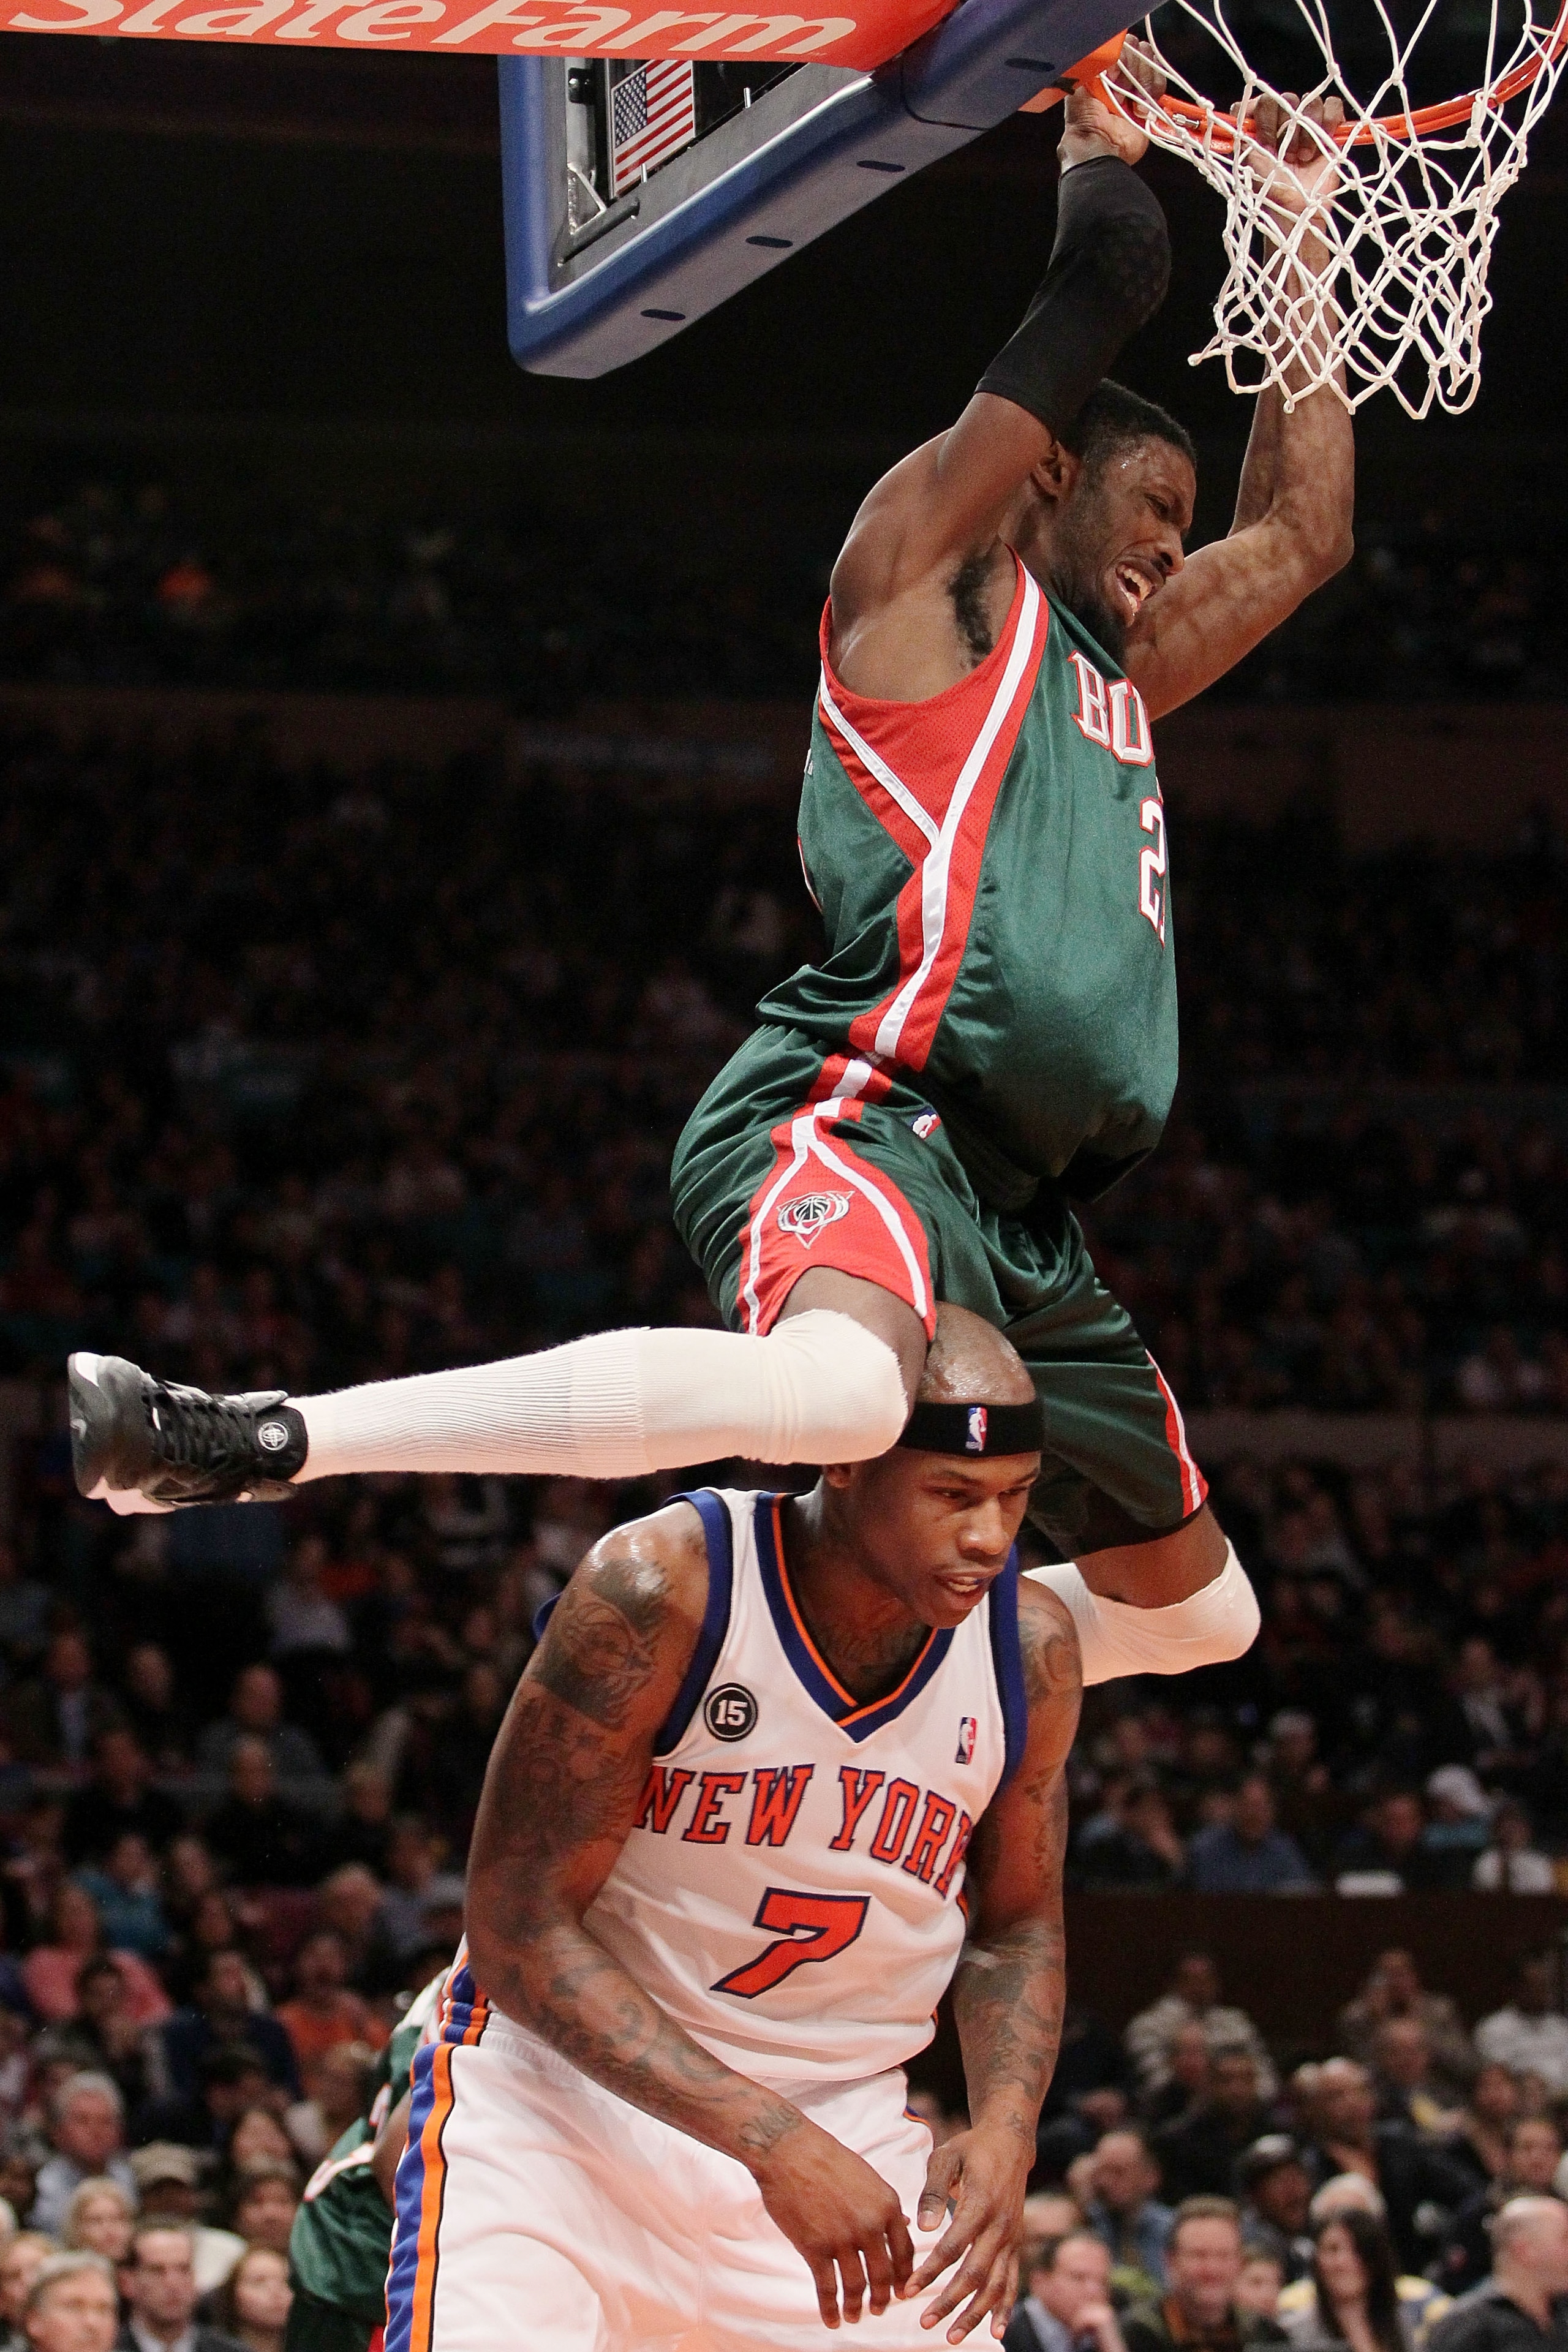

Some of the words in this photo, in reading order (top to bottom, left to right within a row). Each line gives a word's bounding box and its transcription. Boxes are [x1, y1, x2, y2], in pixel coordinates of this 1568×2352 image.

[431, 0, 856, 55] Farm
[715, 1699, 748, 1726] 15
[633, 1763, 815, 1847] NEW
[709, 1887, 872, 1999] 7
